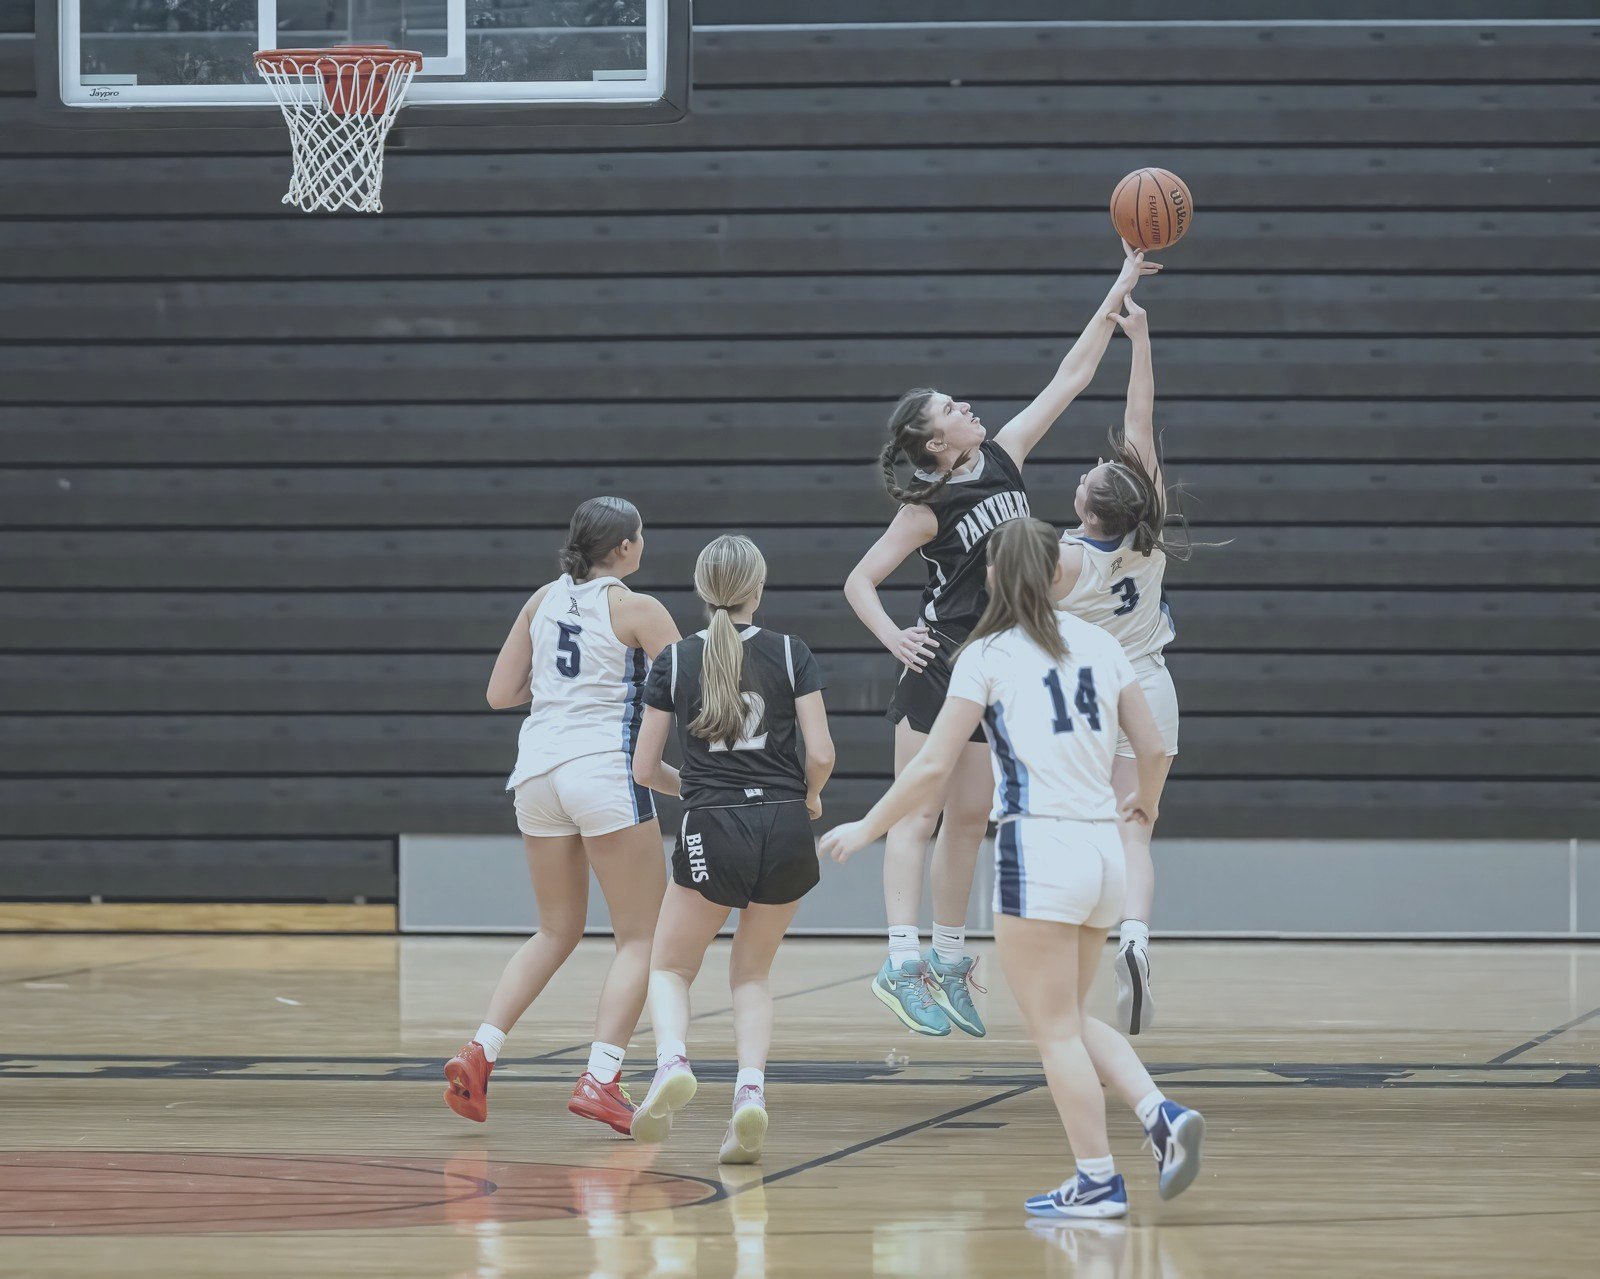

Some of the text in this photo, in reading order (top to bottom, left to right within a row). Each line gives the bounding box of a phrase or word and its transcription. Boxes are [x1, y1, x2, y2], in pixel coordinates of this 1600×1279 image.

[89, 88, 120, 98] Jaypro
[1110, 576, 1140, 617] 3
[556, 620, 583, 679] 5
[707, 690, 769, 753] 2
[1042, 666, 1102, 735] 14
[686, 832, 710, 883] BRHS
